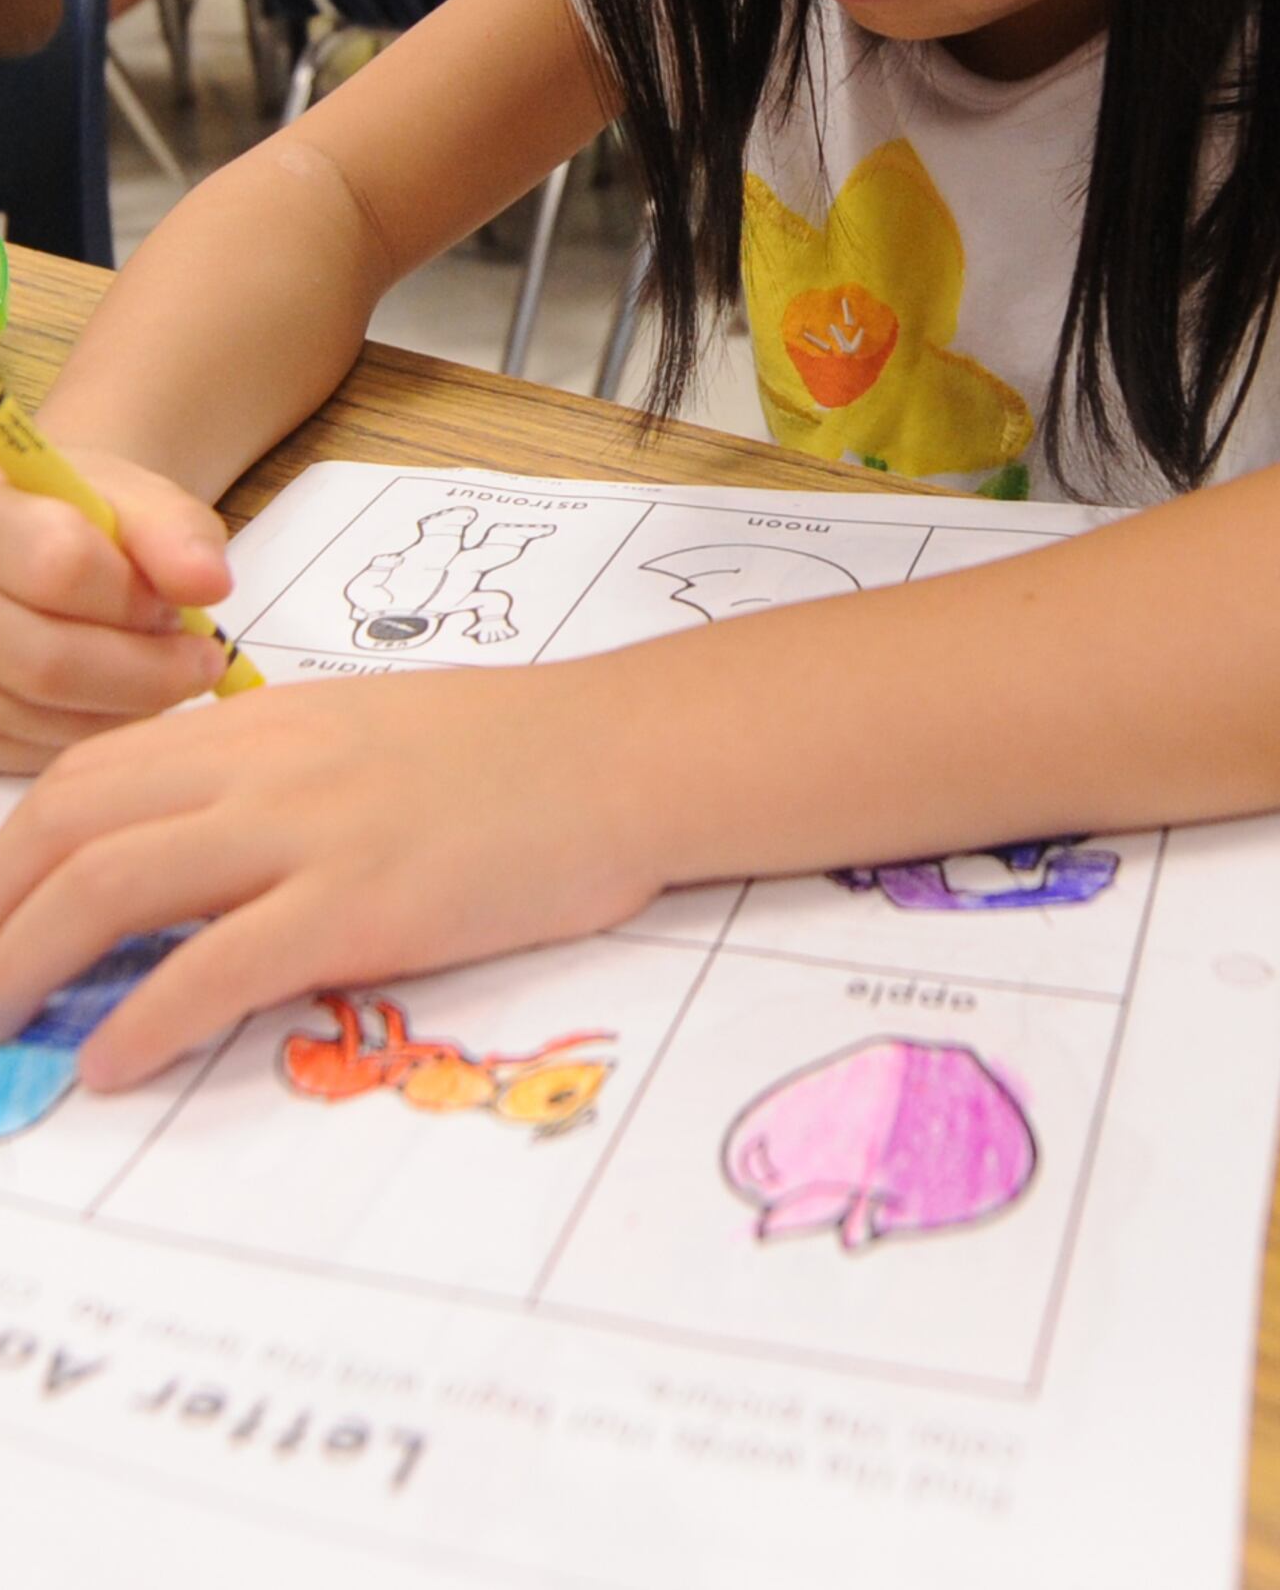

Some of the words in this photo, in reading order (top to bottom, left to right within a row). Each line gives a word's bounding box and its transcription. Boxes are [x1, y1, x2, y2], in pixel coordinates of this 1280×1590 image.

[445, 486, 589, 512] astronaut
[747, 515, 832, 535] moon
[298, 657, 403, 676] plane
[845, 976, 978, 1014] apple
[131, 1377, 428, 1494] Letter
